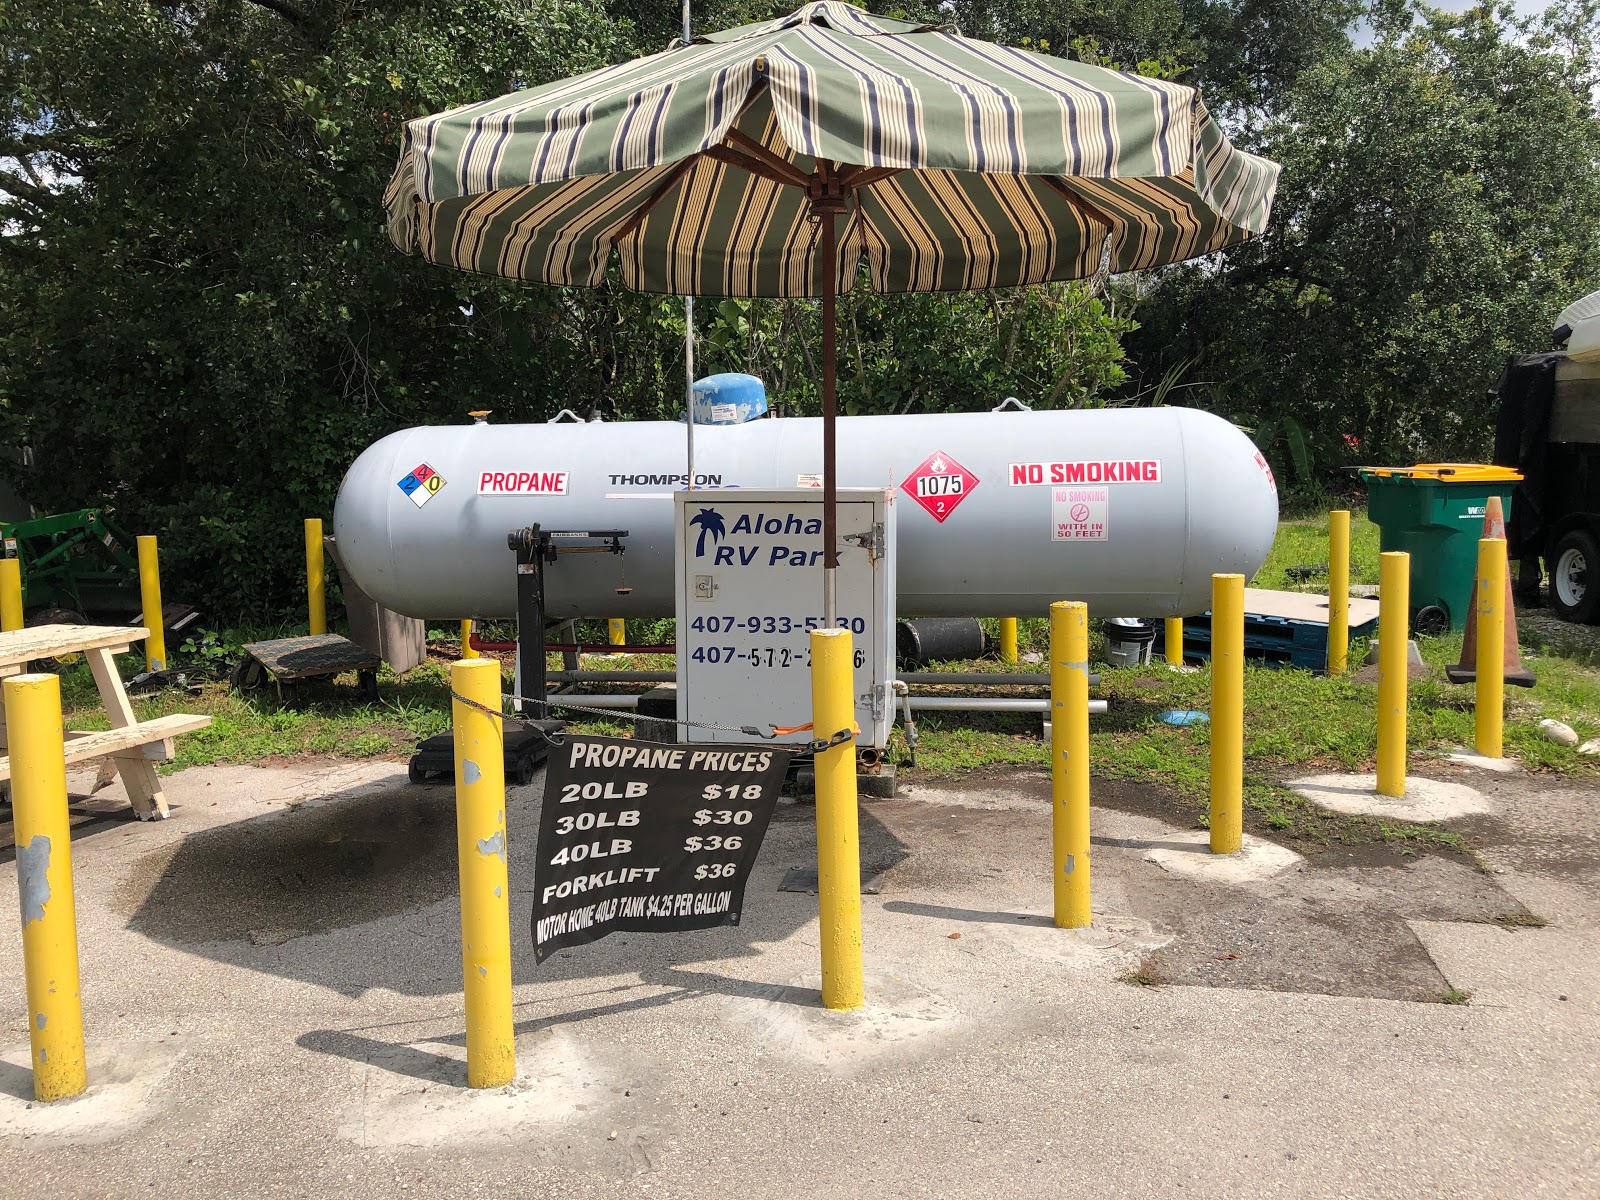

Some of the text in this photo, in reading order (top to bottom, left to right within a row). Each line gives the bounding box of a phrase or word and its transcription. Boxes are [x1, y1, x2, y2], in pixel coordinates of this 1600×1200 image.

[417, 465, 429, 479] 4
[480, 472, 566, 492] PROPANE
[608, 475, 722, 486] THOMPSON
[1013, 462, 1157, 484] NO SMOKING
[404, 476, 416, 490] 2
[429, 476, 441, 491] 0
[920, 475, 962, 495] 1075
[1055, 491, 1105, 502] NO SMOKING
[937, 502, 945, 512] 2
[730, 513, 823, 535] Aloha
[714, 546, 759, 566] RV
[691, 616, 865, 634] 407-933-530
[569, 742, 772, 771] PROPANE PRICES
[559, 781, 763, 803] 20LB $18
[555, 808, 753, 835] 30LB $30
[550, 835, 743, 866] 40LB $36
[542, 863, 737, 904] FORKLIFT $36
[537, 891, 732, 945] MOTOR HOME 40LB TANK $4.25 PER GALLON
